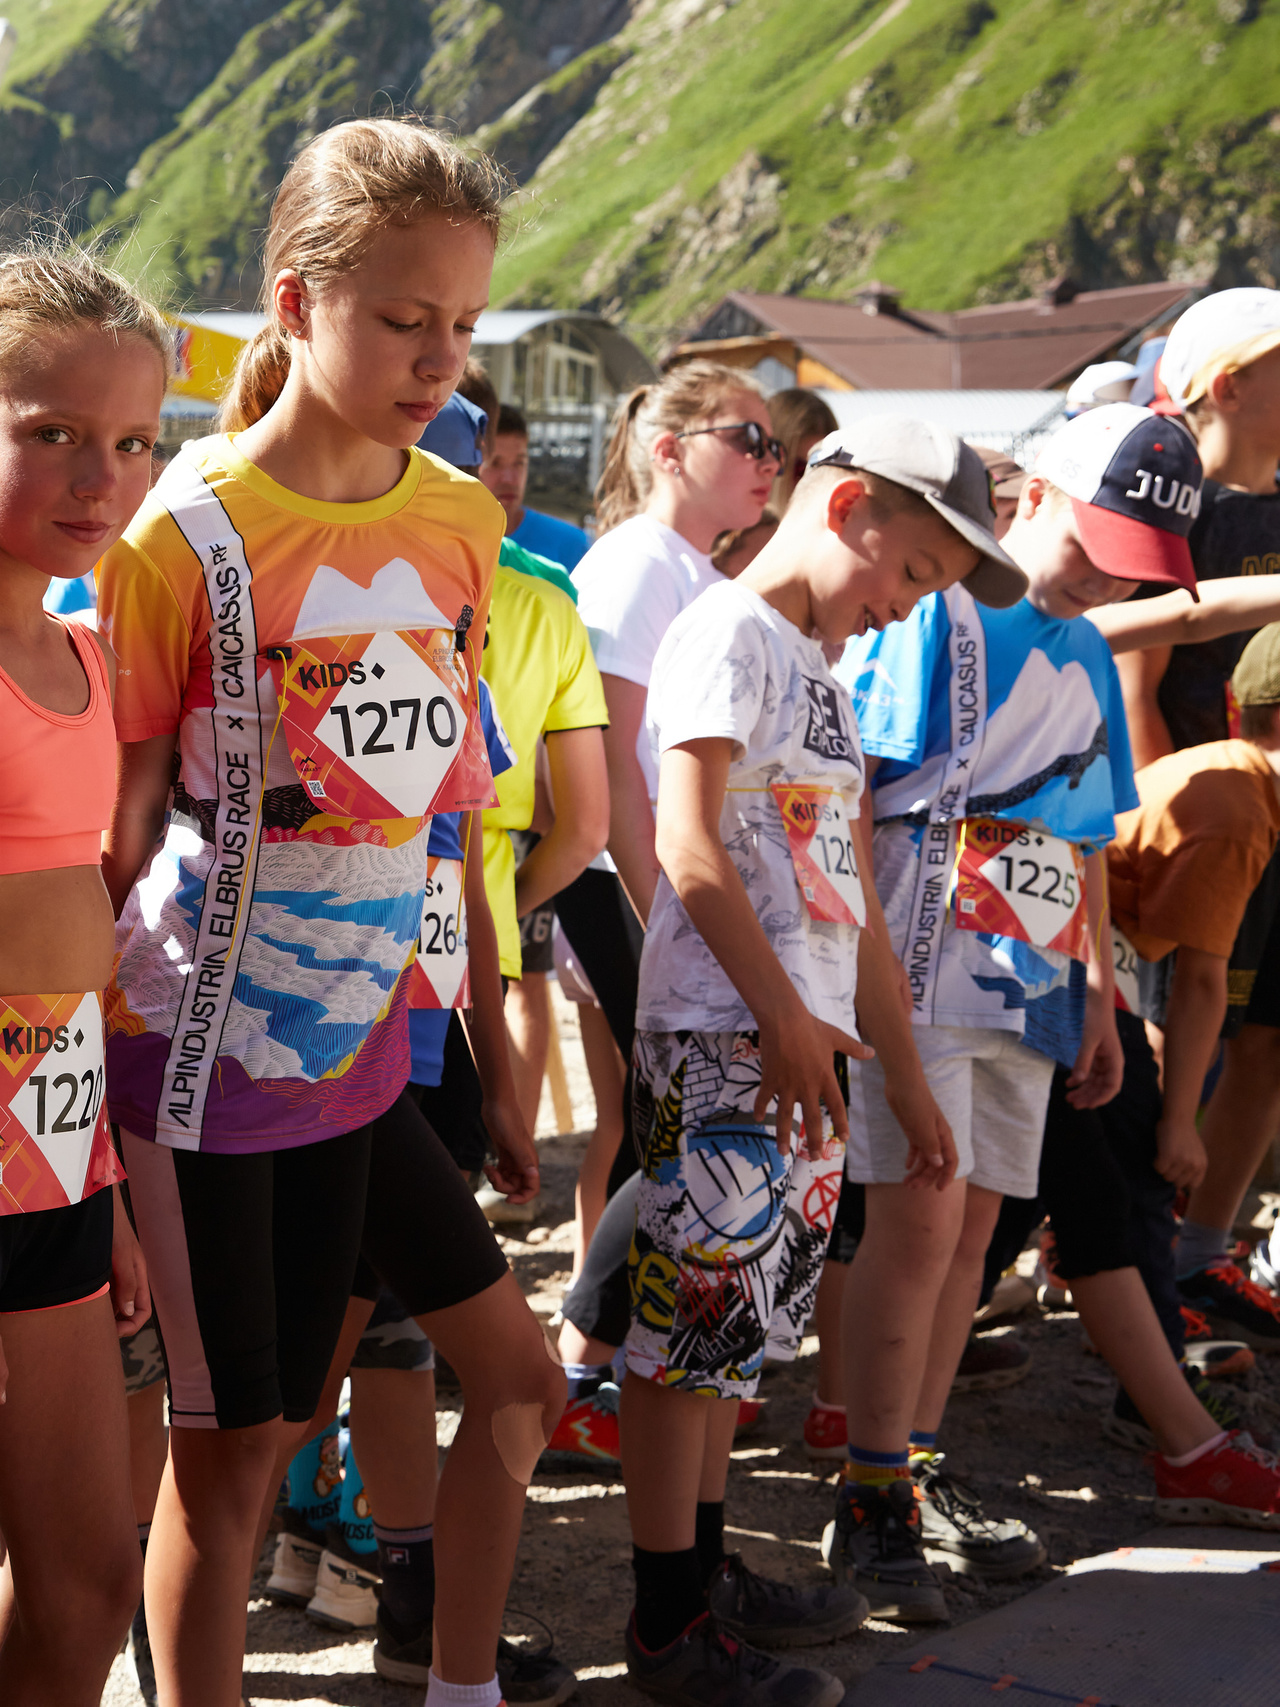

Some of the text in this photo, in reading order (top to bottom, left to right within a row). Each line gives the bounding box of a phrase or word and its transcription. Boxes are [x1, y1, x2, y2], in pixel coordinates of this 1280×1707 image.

[298, 660, 367, 690] KIDS
[957, 640, 979, 746] CAUCASUS
[329, 695, 457, 758] 1270
[225, 751, 250, 826] RACE
[791, 802, 833, 822] KIDS
[976, 826, 1031, 846] KIDS
[209, 830, 247, 937] ELBRUS
[998, 855, 1075, 909] 1225
[2, 1025, 70, 1055] KIDS
[28, 1064, 103, 1135] 1220
